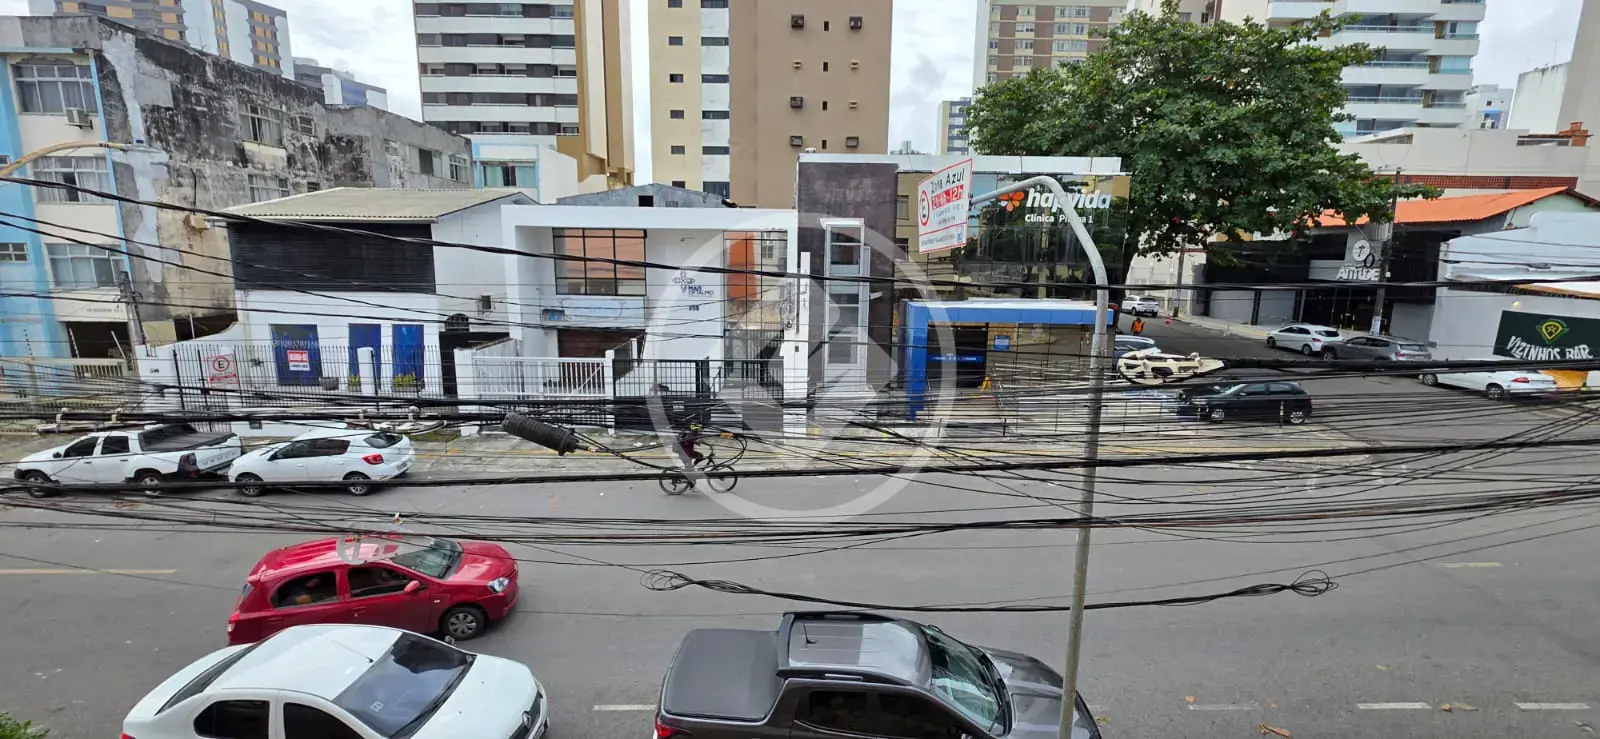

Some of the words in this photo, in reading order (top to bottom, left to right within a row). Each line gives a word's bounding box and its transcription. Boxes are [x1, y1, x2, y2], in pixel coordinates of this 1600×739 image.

[930, 179, 943, 194] Zona
[946, 168, 965, 186] Azul
[1025, 187, 1112, 213] hapvida
[1024, 213, 1055, 223] Clínica
[1506, 335, 1560, 360] VIZINHOS
[218, 360, 225, 369] E
